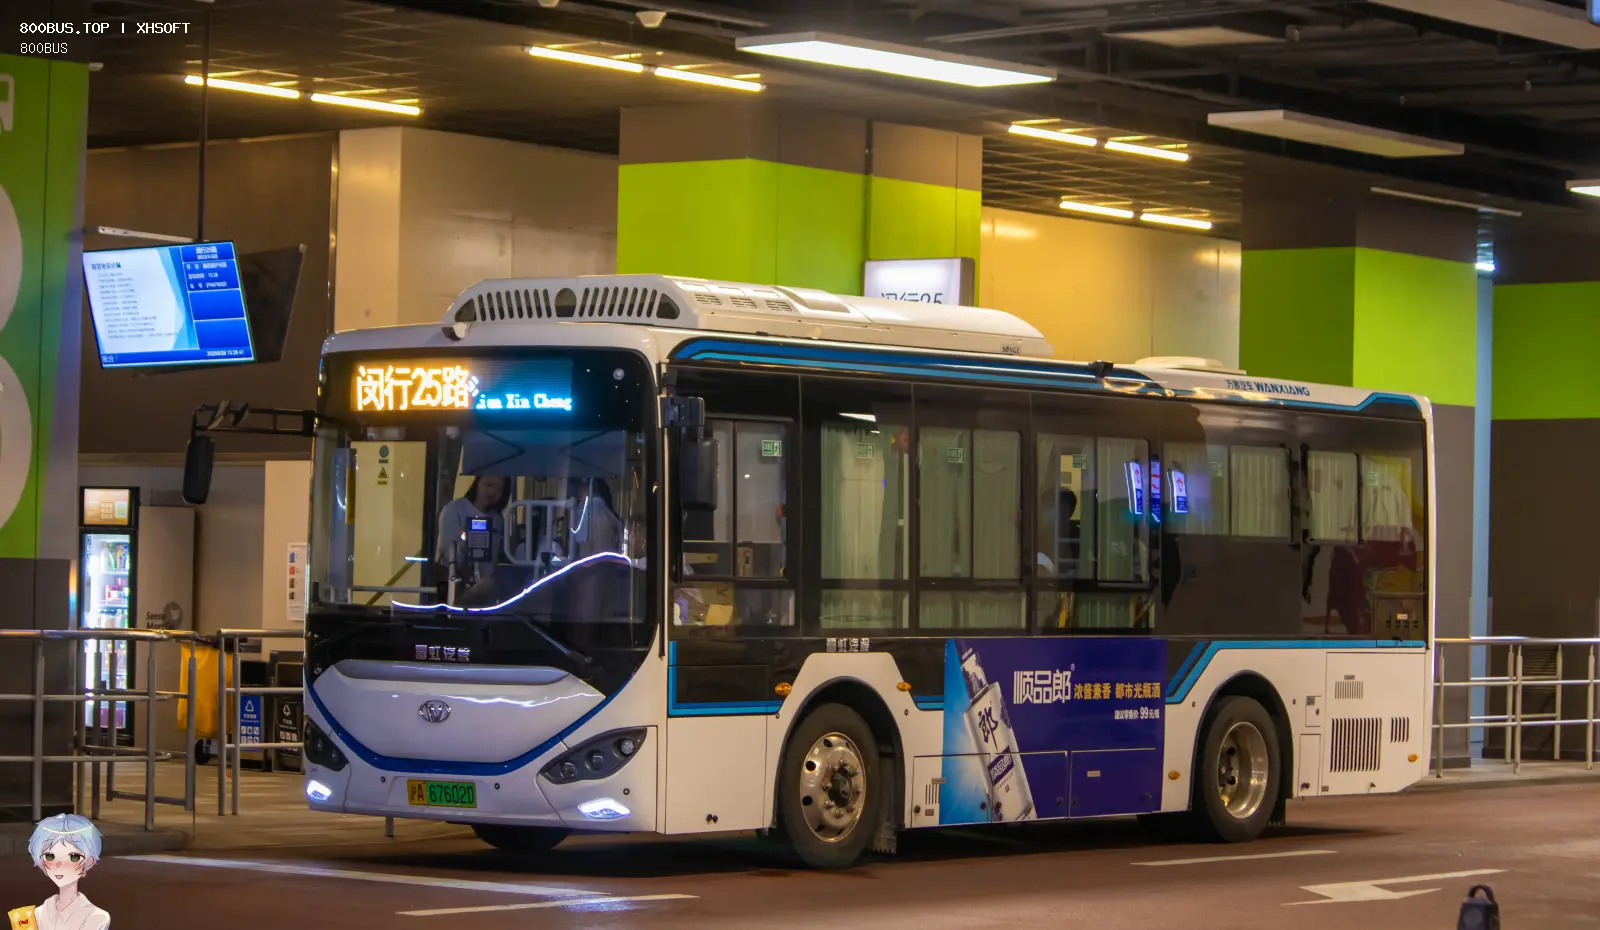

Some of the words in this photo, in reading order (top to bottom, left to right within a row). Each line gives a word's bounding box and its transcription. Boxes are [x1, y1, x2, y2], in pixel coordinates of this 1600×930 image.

[356, 365, 470, 410] 闵行25路
[1254, 381, 1310, 396] WANXIANG
[506, 394, 530, 409] Xin
[1013, 669, 1072, 705] 顺品郎
[1073, 682, 1111, 700] 浓酱兼香
[1115, 682, 1161, 699] 都市光瓶酒
